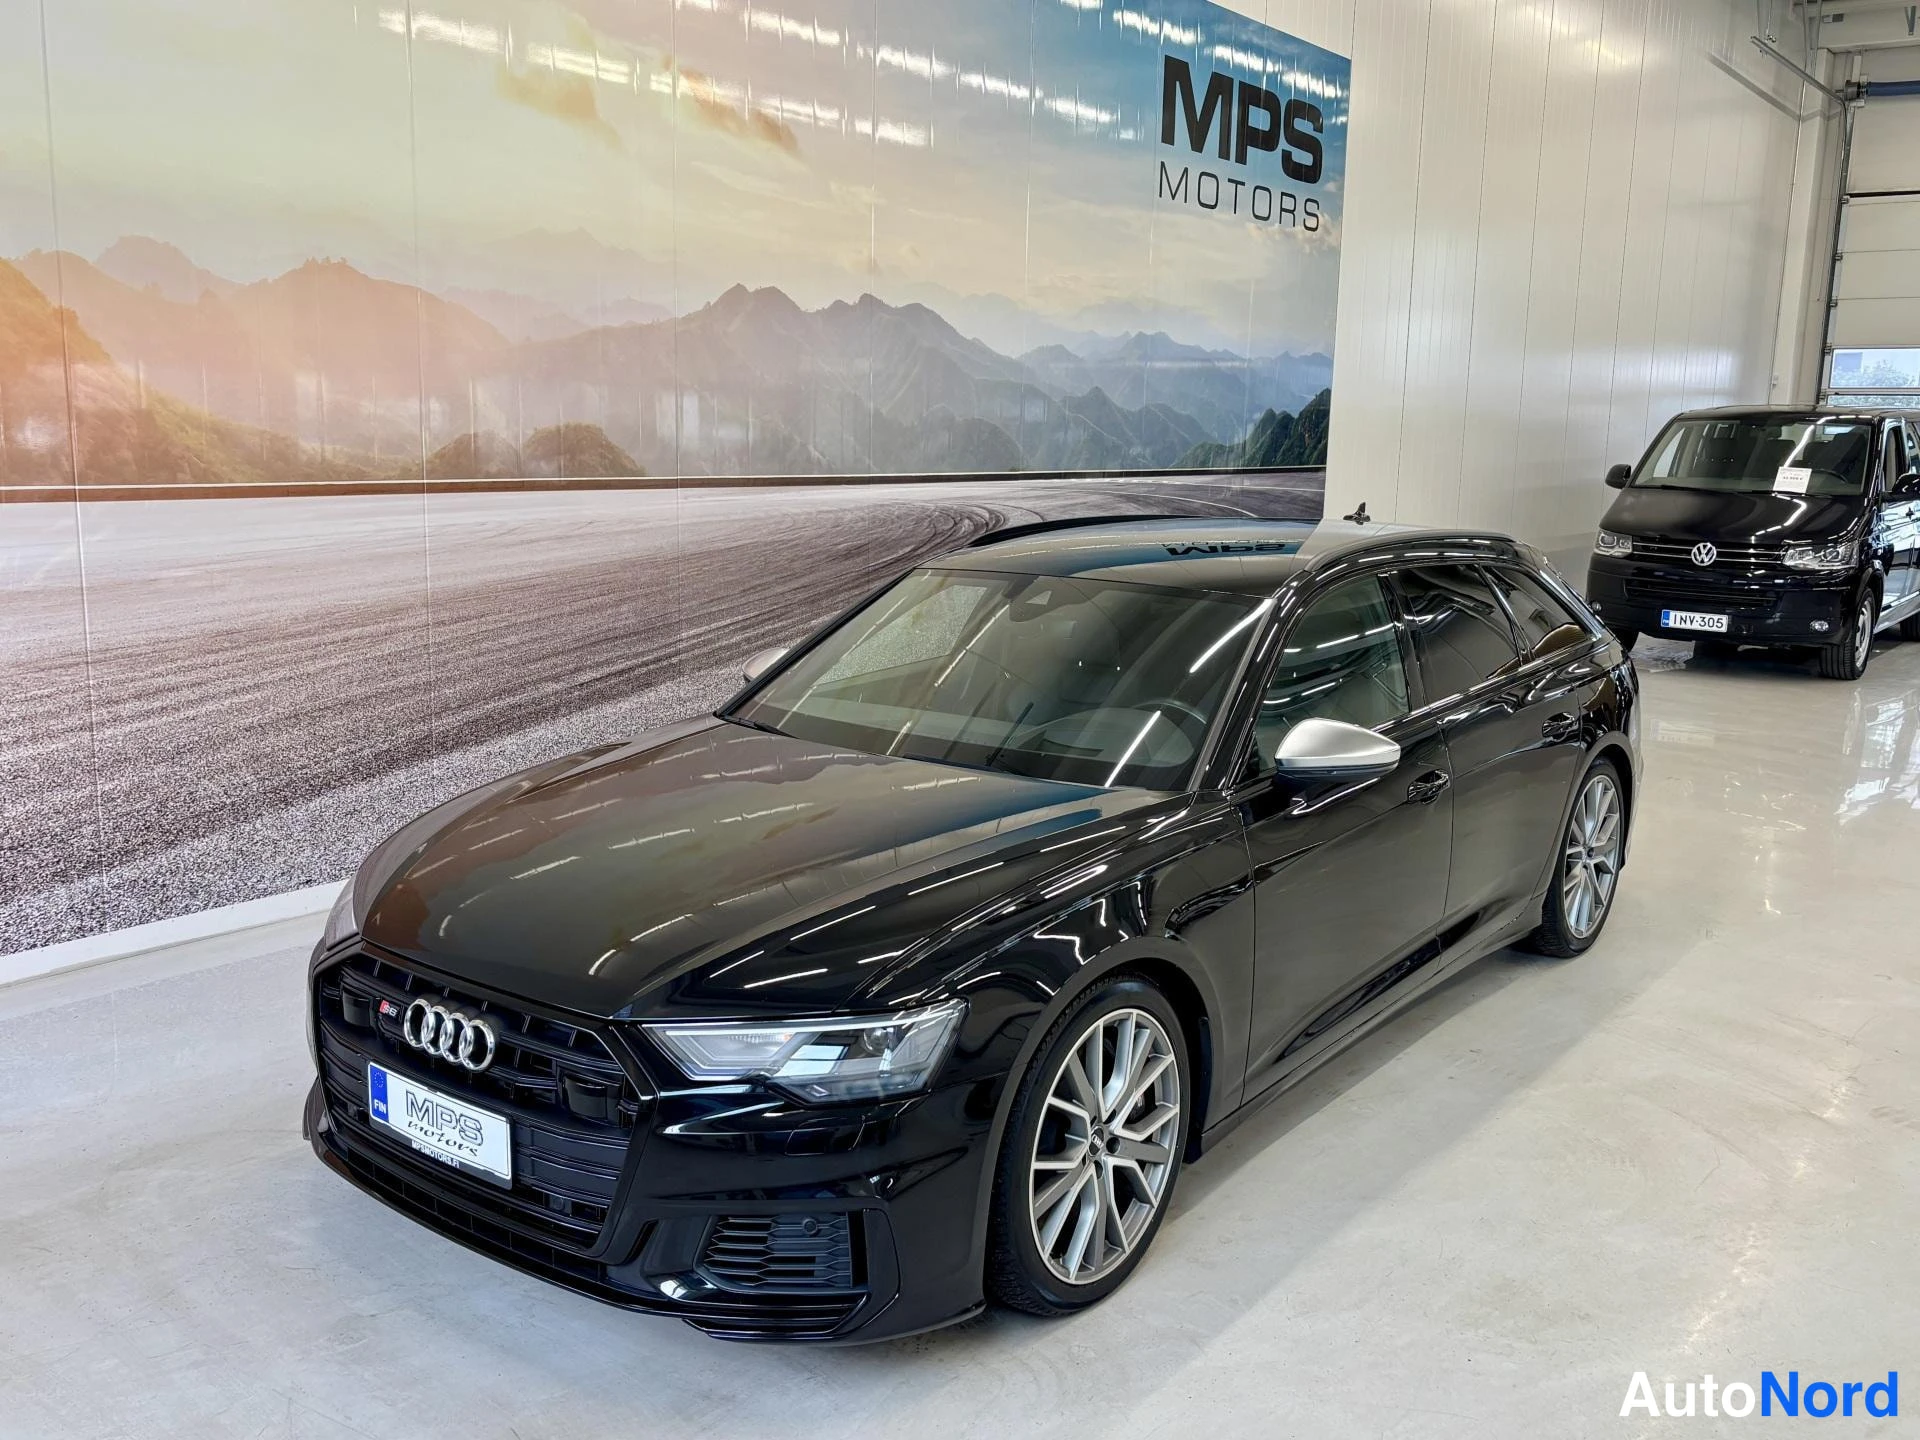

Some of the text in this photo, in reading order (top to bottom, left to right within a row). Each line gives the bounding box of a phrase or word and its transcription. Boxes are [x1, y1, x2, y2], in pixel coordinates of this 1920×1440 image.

[1161, 54, 1323, 184] MPS
[1159, 161, 1320, 232] MOTORS
[1673, 613, 1724, 629] INV-305
[374, 1099, 387, 1114] FIN
[406, 1089, 484, 1147] MPS
[407, 1120, 478, 1157] motors
[411, 1140, 460, 1168] MPSMOTORS.FI
